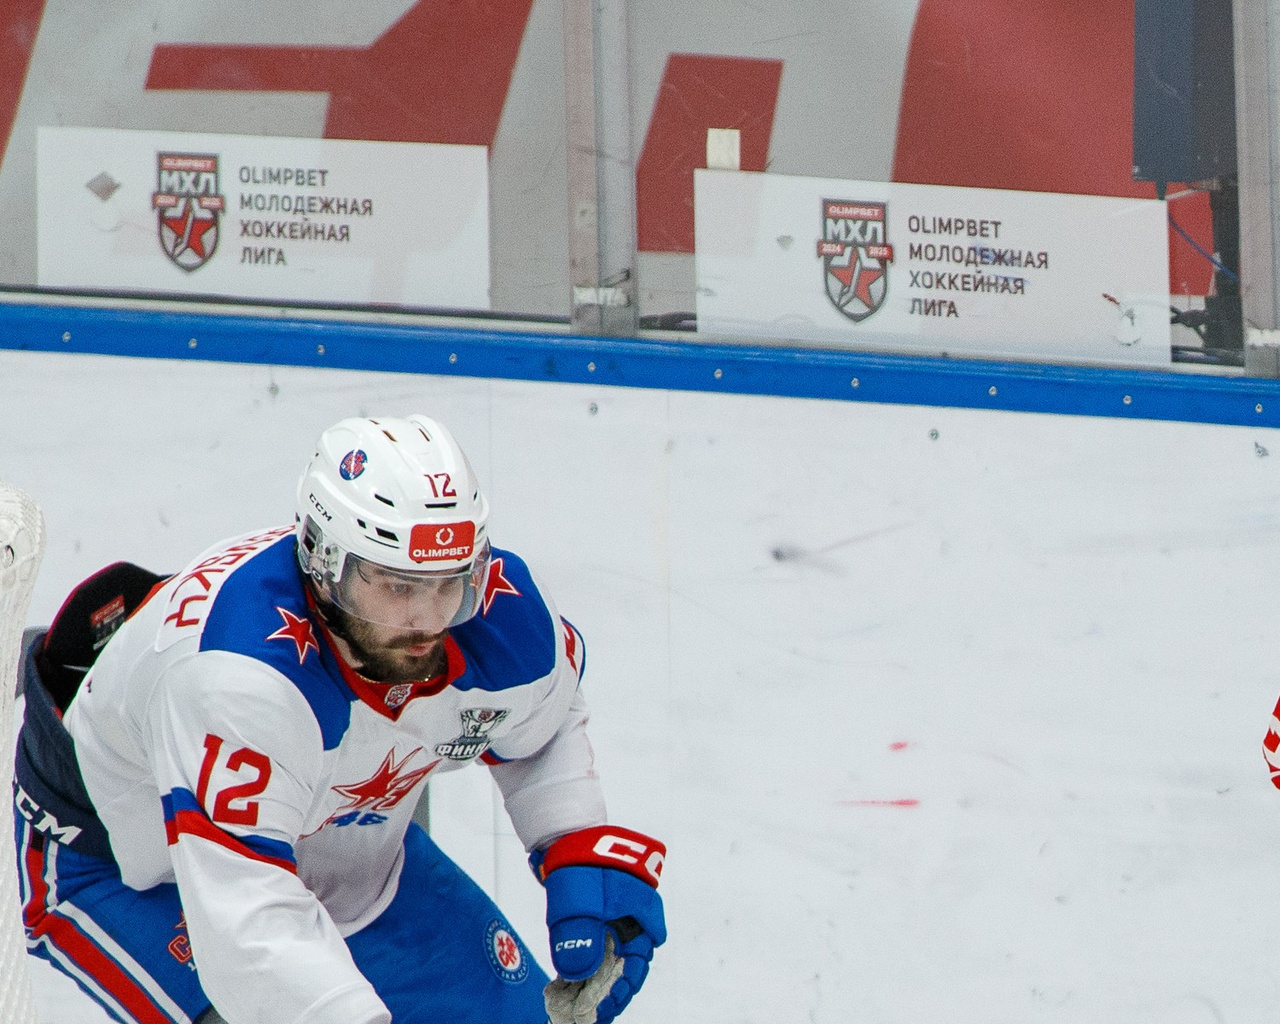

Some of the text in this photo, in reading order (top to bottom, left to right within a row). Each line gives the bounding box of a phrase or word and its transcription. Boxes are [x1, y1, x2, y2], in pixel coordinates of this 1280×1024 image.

[162, 171, 216, 195] МХЛ
[239, 166, 328, 187] OLIMPBET
[240, 194, 373, 216] МОЛОДЕЖНАЯ
[829, 206, 880, 217] OLIMPBET
[240, 218, 350, 242] ХОККЕЙНАЯ
[826, 219, 883, 243] МХЛ
[908, 215, 1001, 238] OLIMPBET
[241, 247, 286, 265] ЛИГА
[909, 243, 1048, 269] МОЛОДЕЖНАЯ
[909, 270, 1025, 295] ХОККЕЙНАЯ
[909, 298, 959, 318] ЛИГА
[423, 473, 457, 498] 12
[309, 493, 332, 522] CCM
[413, 546, 471, 558] OLIMPBET
[196, 733, 272, 827] 12
[15, 785, 83, 846] CM
[592, 834, 666, 880] CC
[555, 938, 593, 953] CCM
